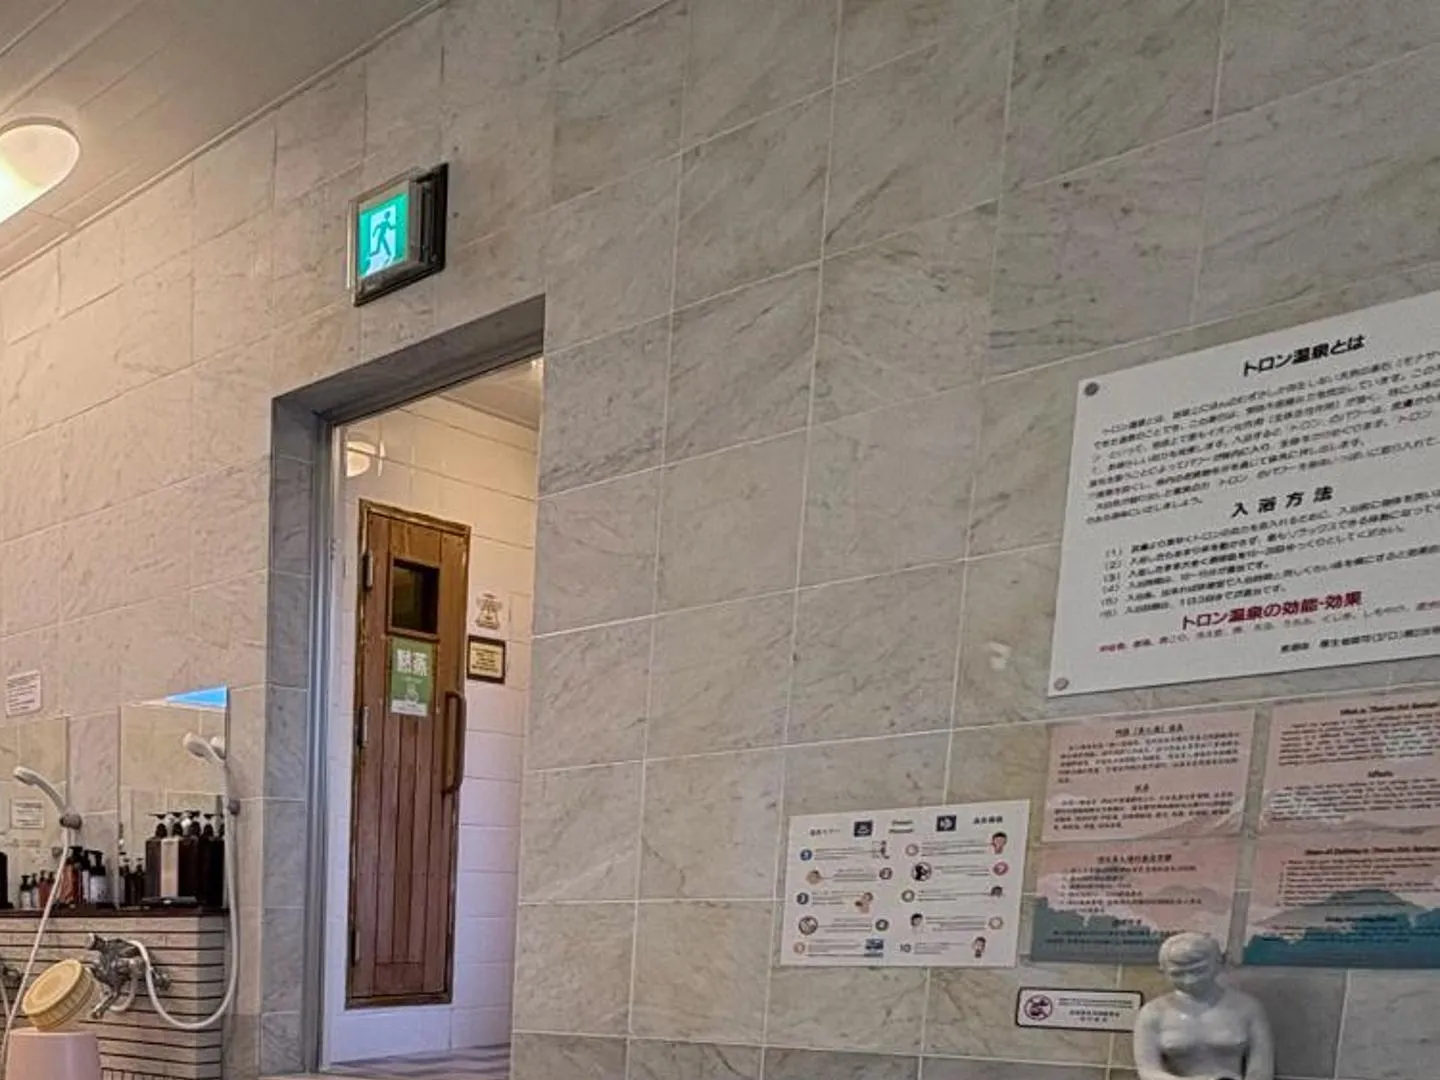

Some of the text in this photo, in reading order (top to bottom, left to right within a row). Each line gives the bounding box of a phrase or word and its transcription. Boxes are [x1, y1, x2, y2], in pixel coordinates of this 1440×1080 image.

[1243, 334, 1365, 377] トロン温泉とは
